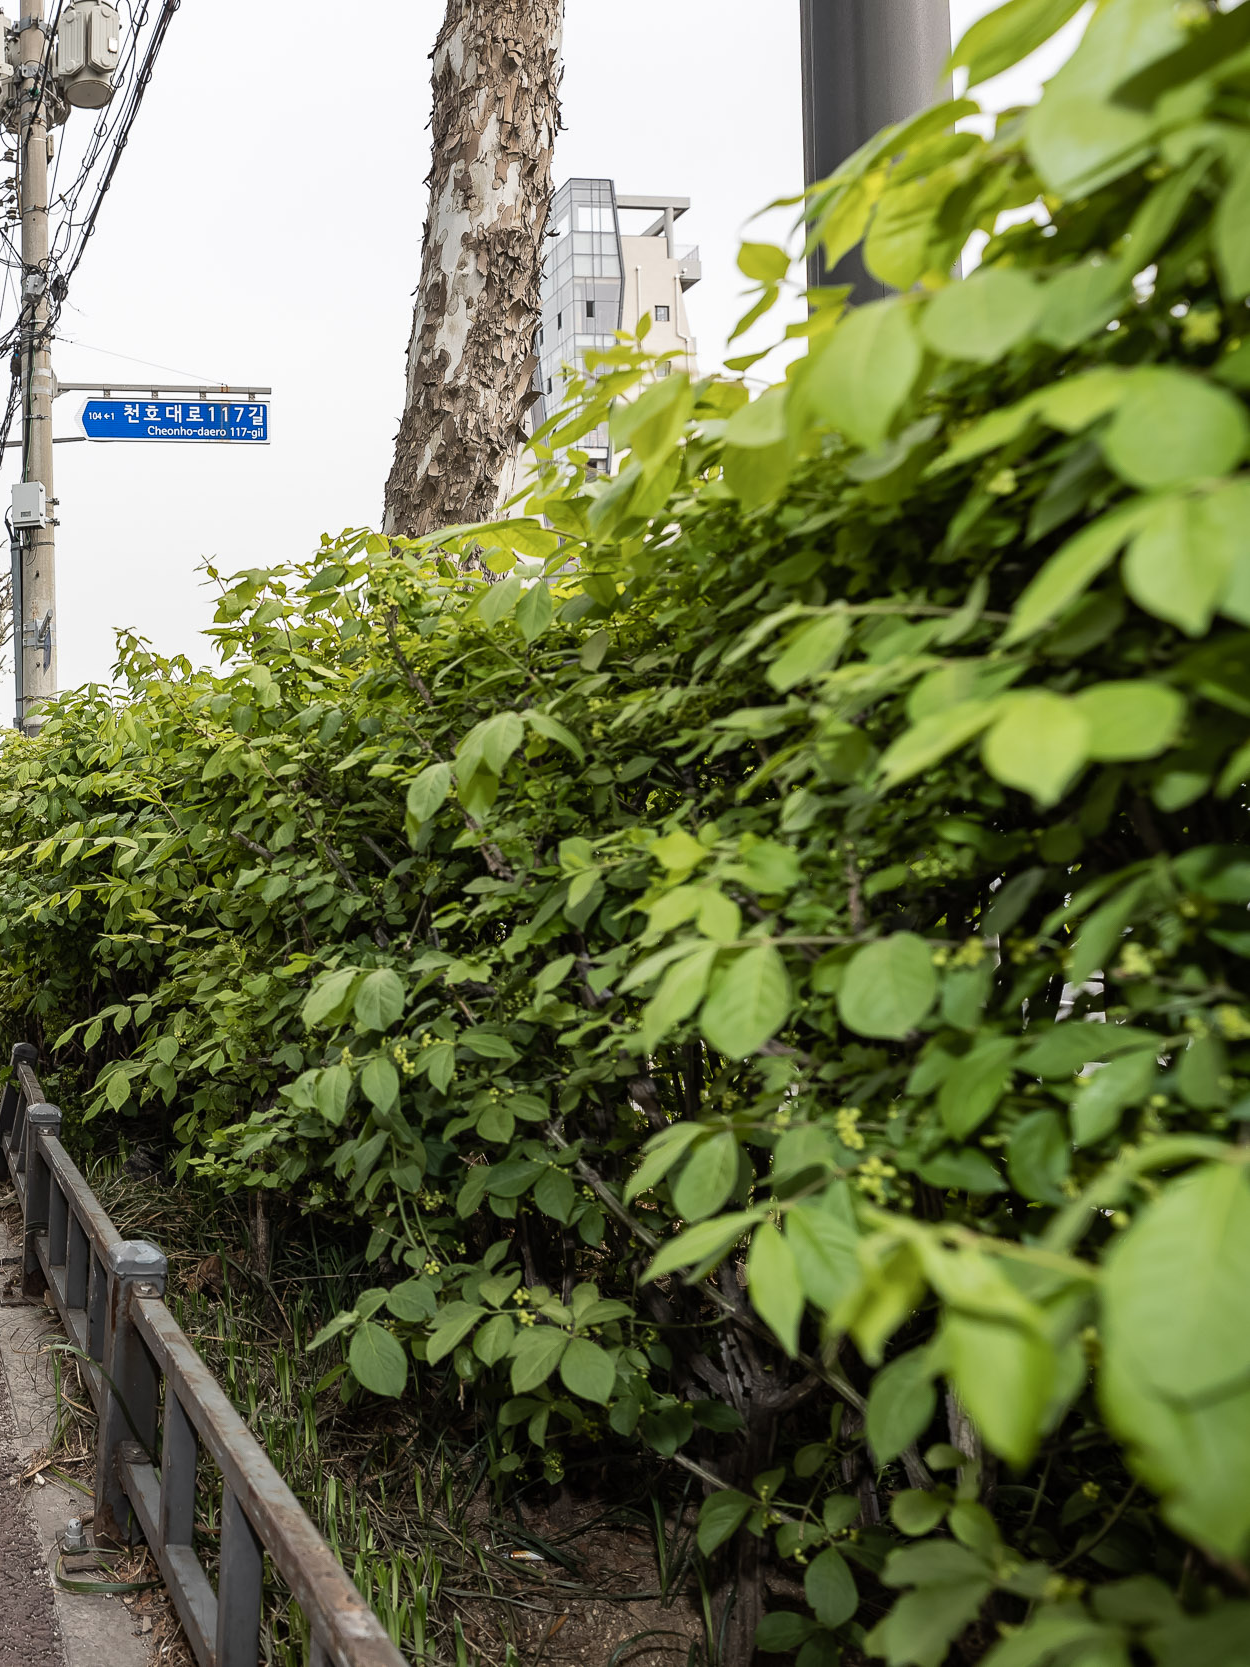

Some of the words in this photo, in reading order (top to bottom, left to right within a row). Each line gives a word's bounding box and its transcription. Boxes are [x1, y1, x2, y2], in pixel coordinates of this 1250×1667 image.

[123, 403, 264, 426] 천호대로117길
[147, 425, 227, 437] Cheonho-daero
[230, 427, 264, 439] 117-gil
